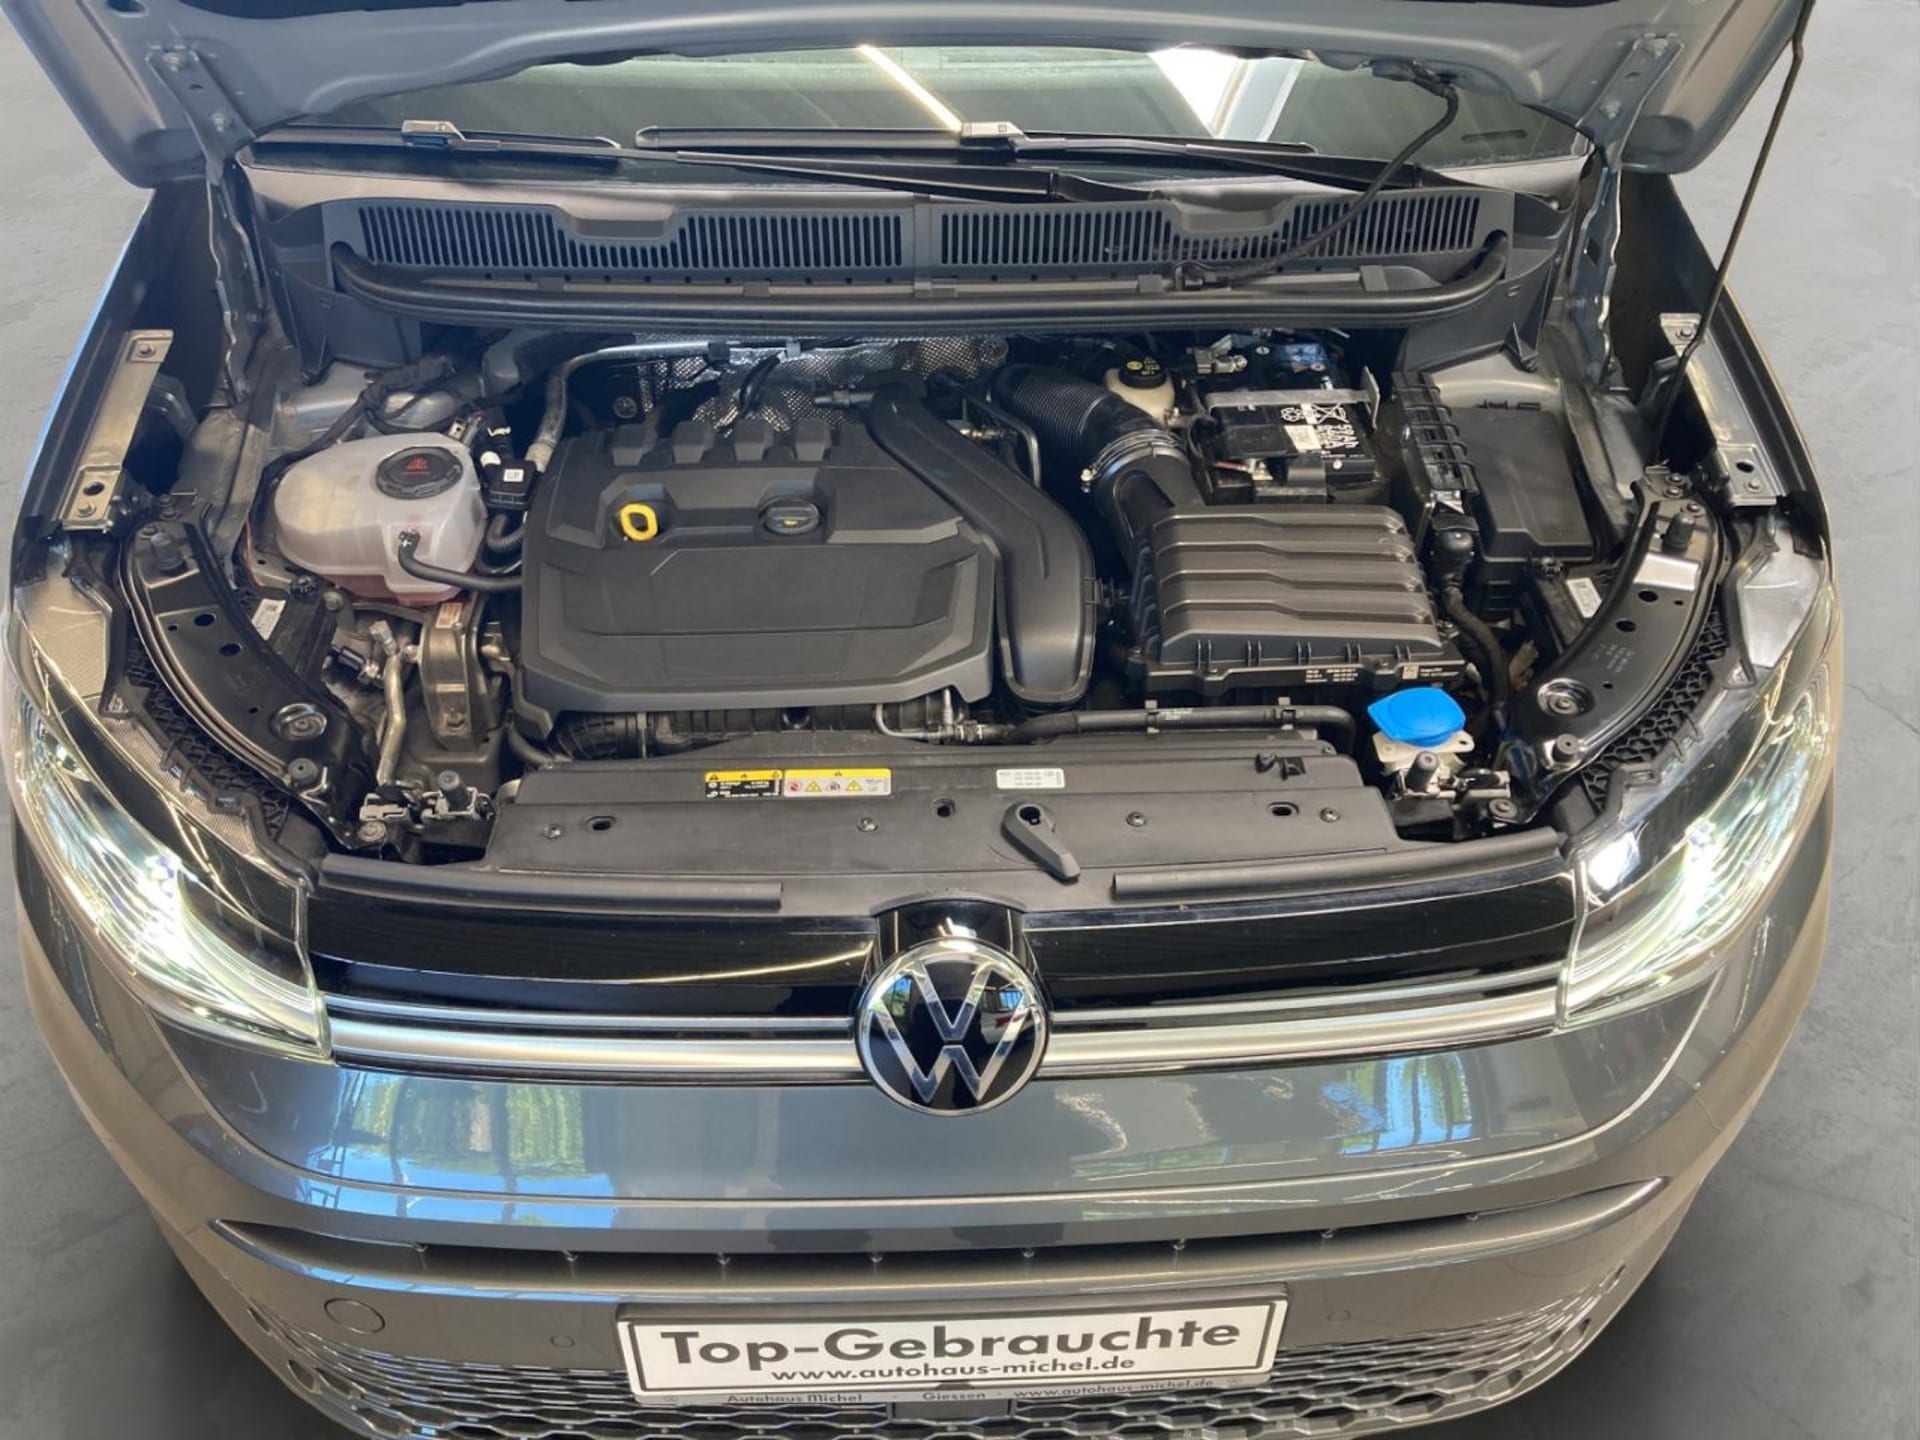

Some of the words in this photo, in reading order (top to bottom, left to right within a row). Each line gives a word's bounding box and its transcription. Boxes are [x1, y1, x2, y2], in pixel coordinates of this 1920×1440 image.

[862, 950, 1042, 1107] VW
[660, 1316, 1241, 1371] Top-Gebrauchte
[770, 1356, 1136, 1381] www.autohaus-michel.de
[726, 1393, 803, 1404] Autohaus
[807, 1392, 863, 1403] Michel
[922, 1390, 987, 1401] Giessen
[1013, 1378, 1214, 1399] www.autohaus-michel.de
